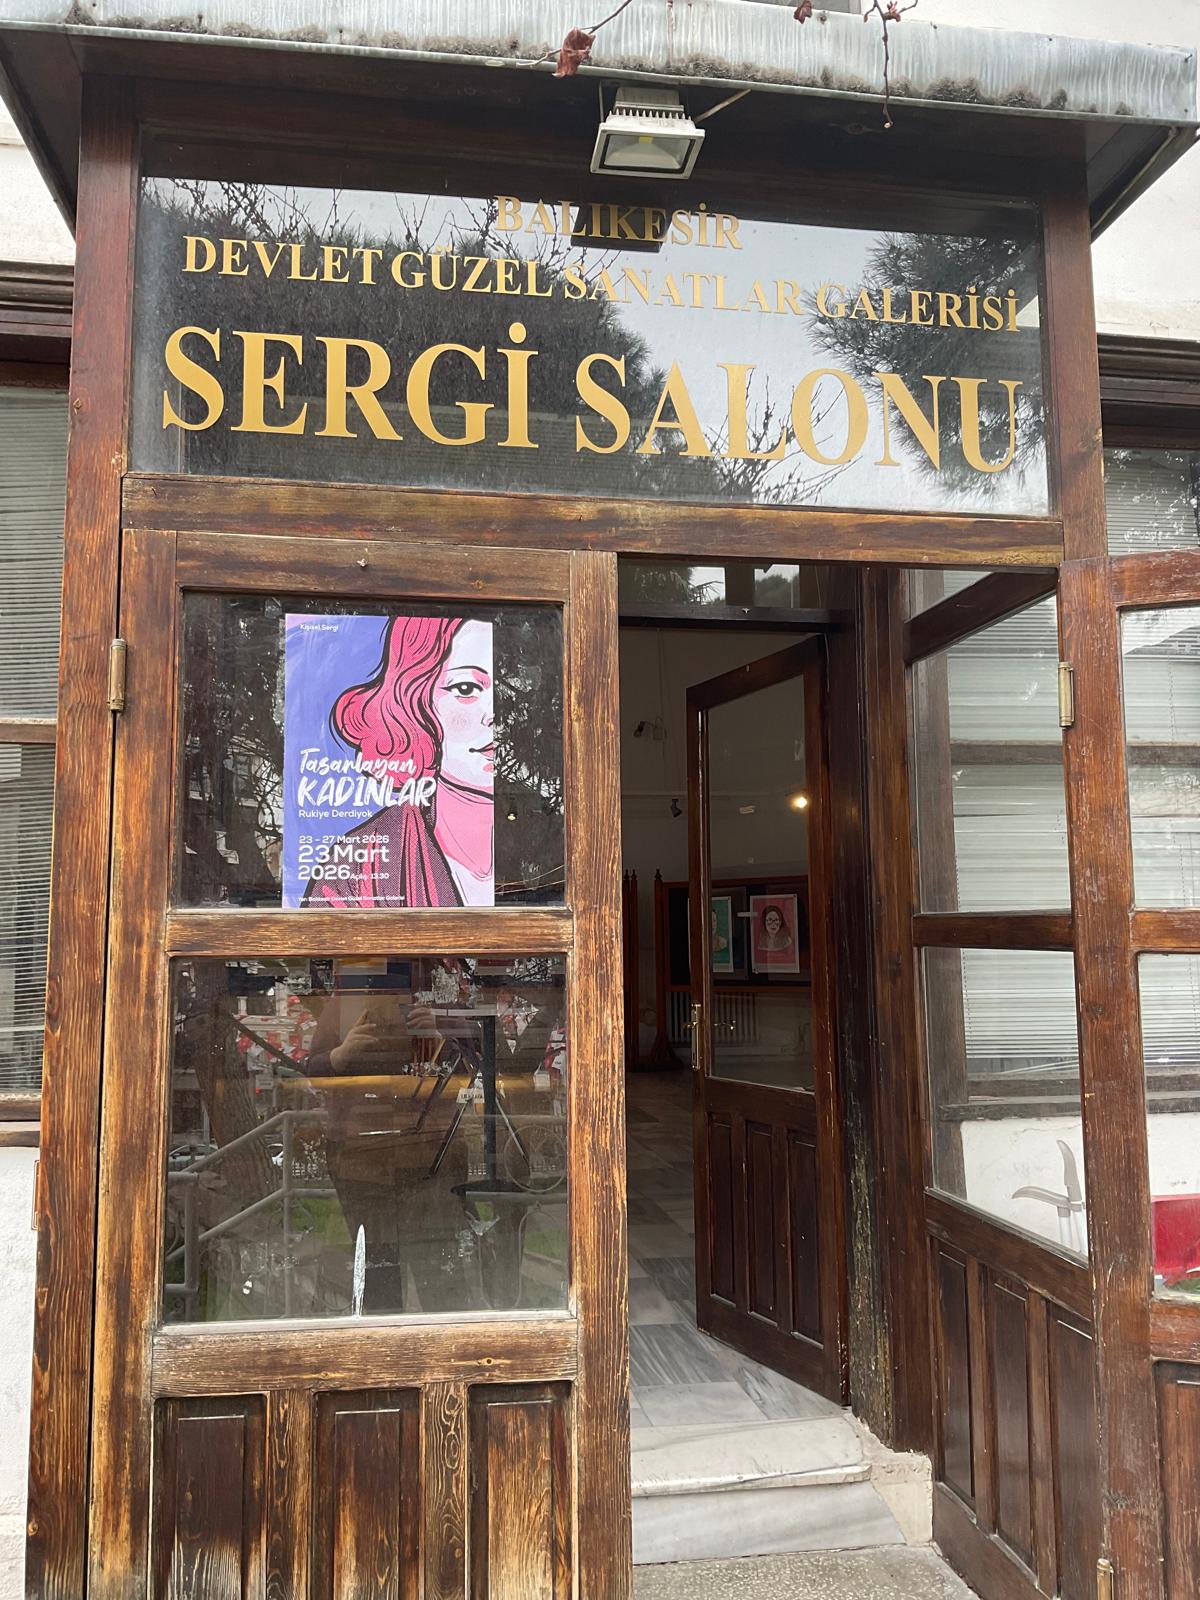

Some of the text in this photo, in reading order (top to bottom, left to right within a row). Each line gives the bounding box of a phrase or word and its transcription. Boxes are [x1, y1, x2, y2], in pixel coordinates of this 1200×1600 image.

[494, 195, 743, 249] BALIKESİR
[182, 235, 1021, 333] DEVLET GÜZEL SANATLAR GALERİSİ
[163, 322, 1024, 474] SERGİ SALONU
[300, 748, 417, 779] Tasarlayan
[297, 776, 437, 807] KADINLAR
[299, 809, 373, 820] Rukiye Derdiyok
[298, 844, 390, 863] 23 Mart
[299, 835, 313, 844] 23
[322, 835, 336, 844] 27
[337, 835, 361, 844] Mart
[361, 834, 390, 844] 2026
[298, 864, 350, 880] 2026
